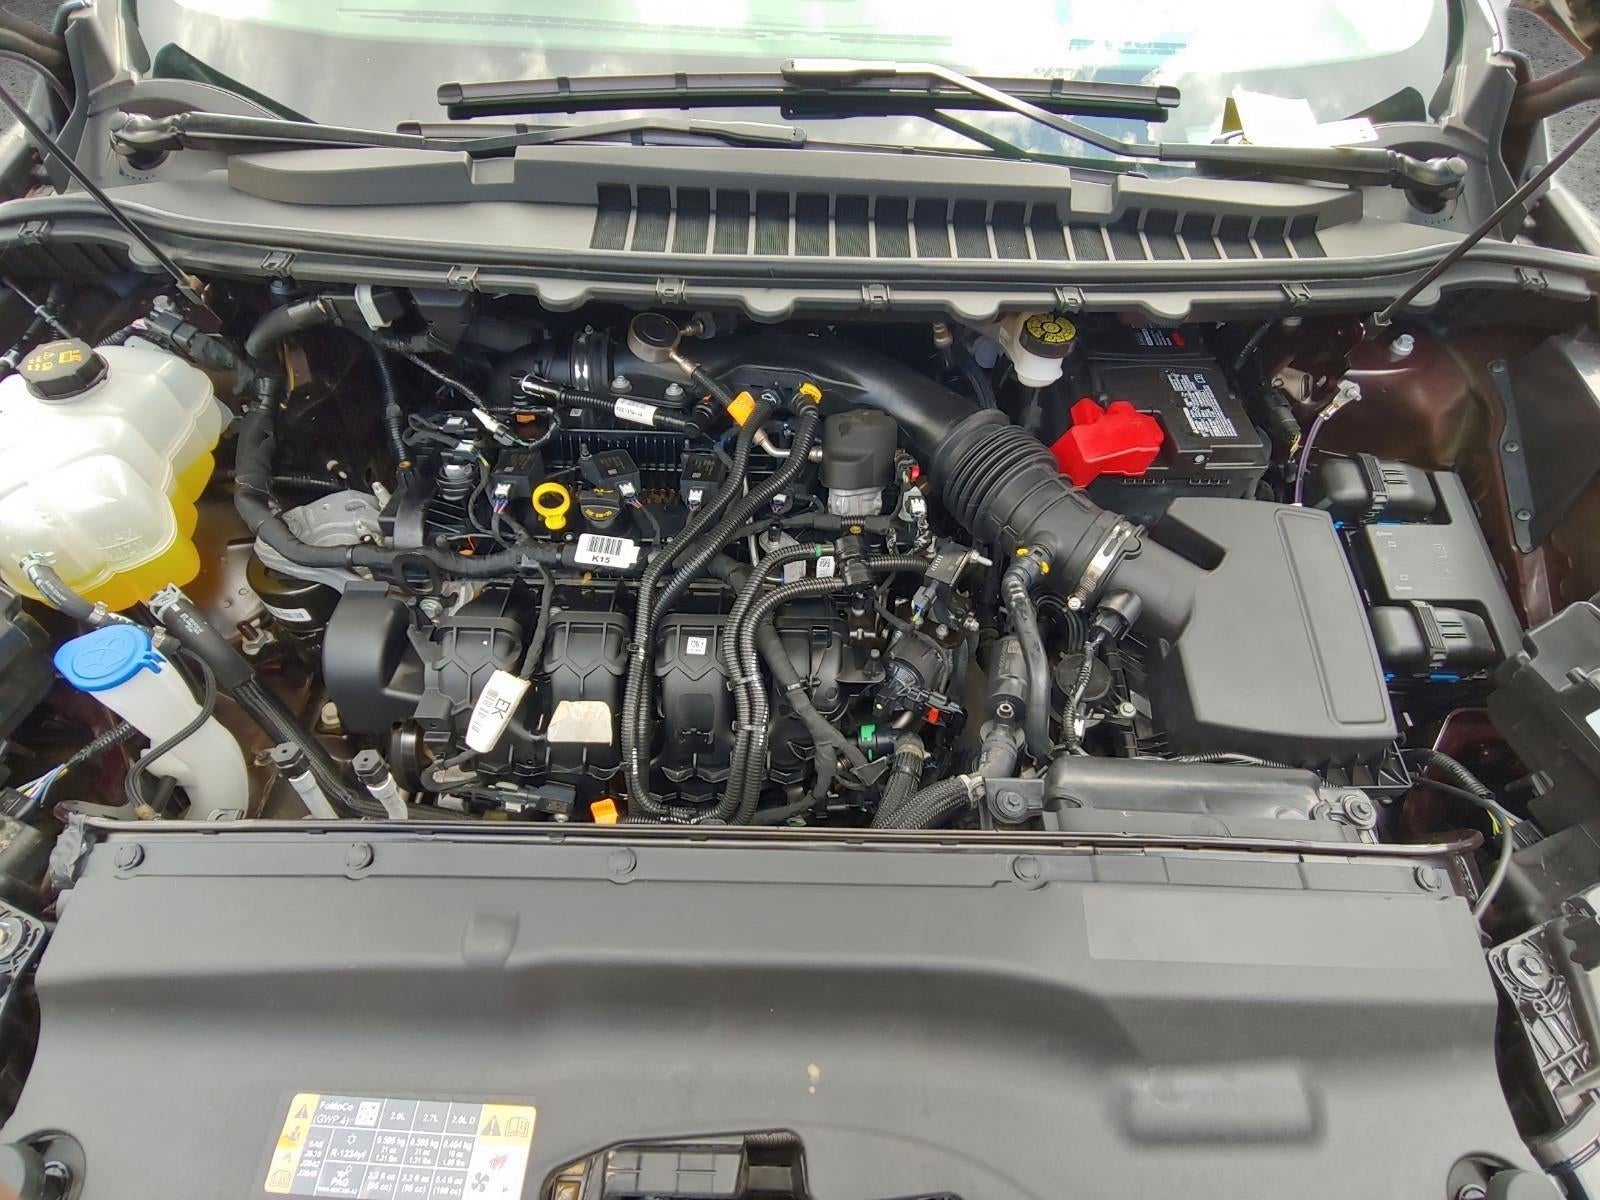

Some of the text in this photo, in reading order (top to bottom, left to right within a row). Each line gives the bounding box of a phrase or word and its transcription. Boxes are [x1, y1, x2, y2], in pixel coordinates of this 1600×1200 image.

[592, 555, 611, 563] K15
[319, 1101, 354, 1111] FoMoCo
[422, 1113, 438, 1122] 2.7L
